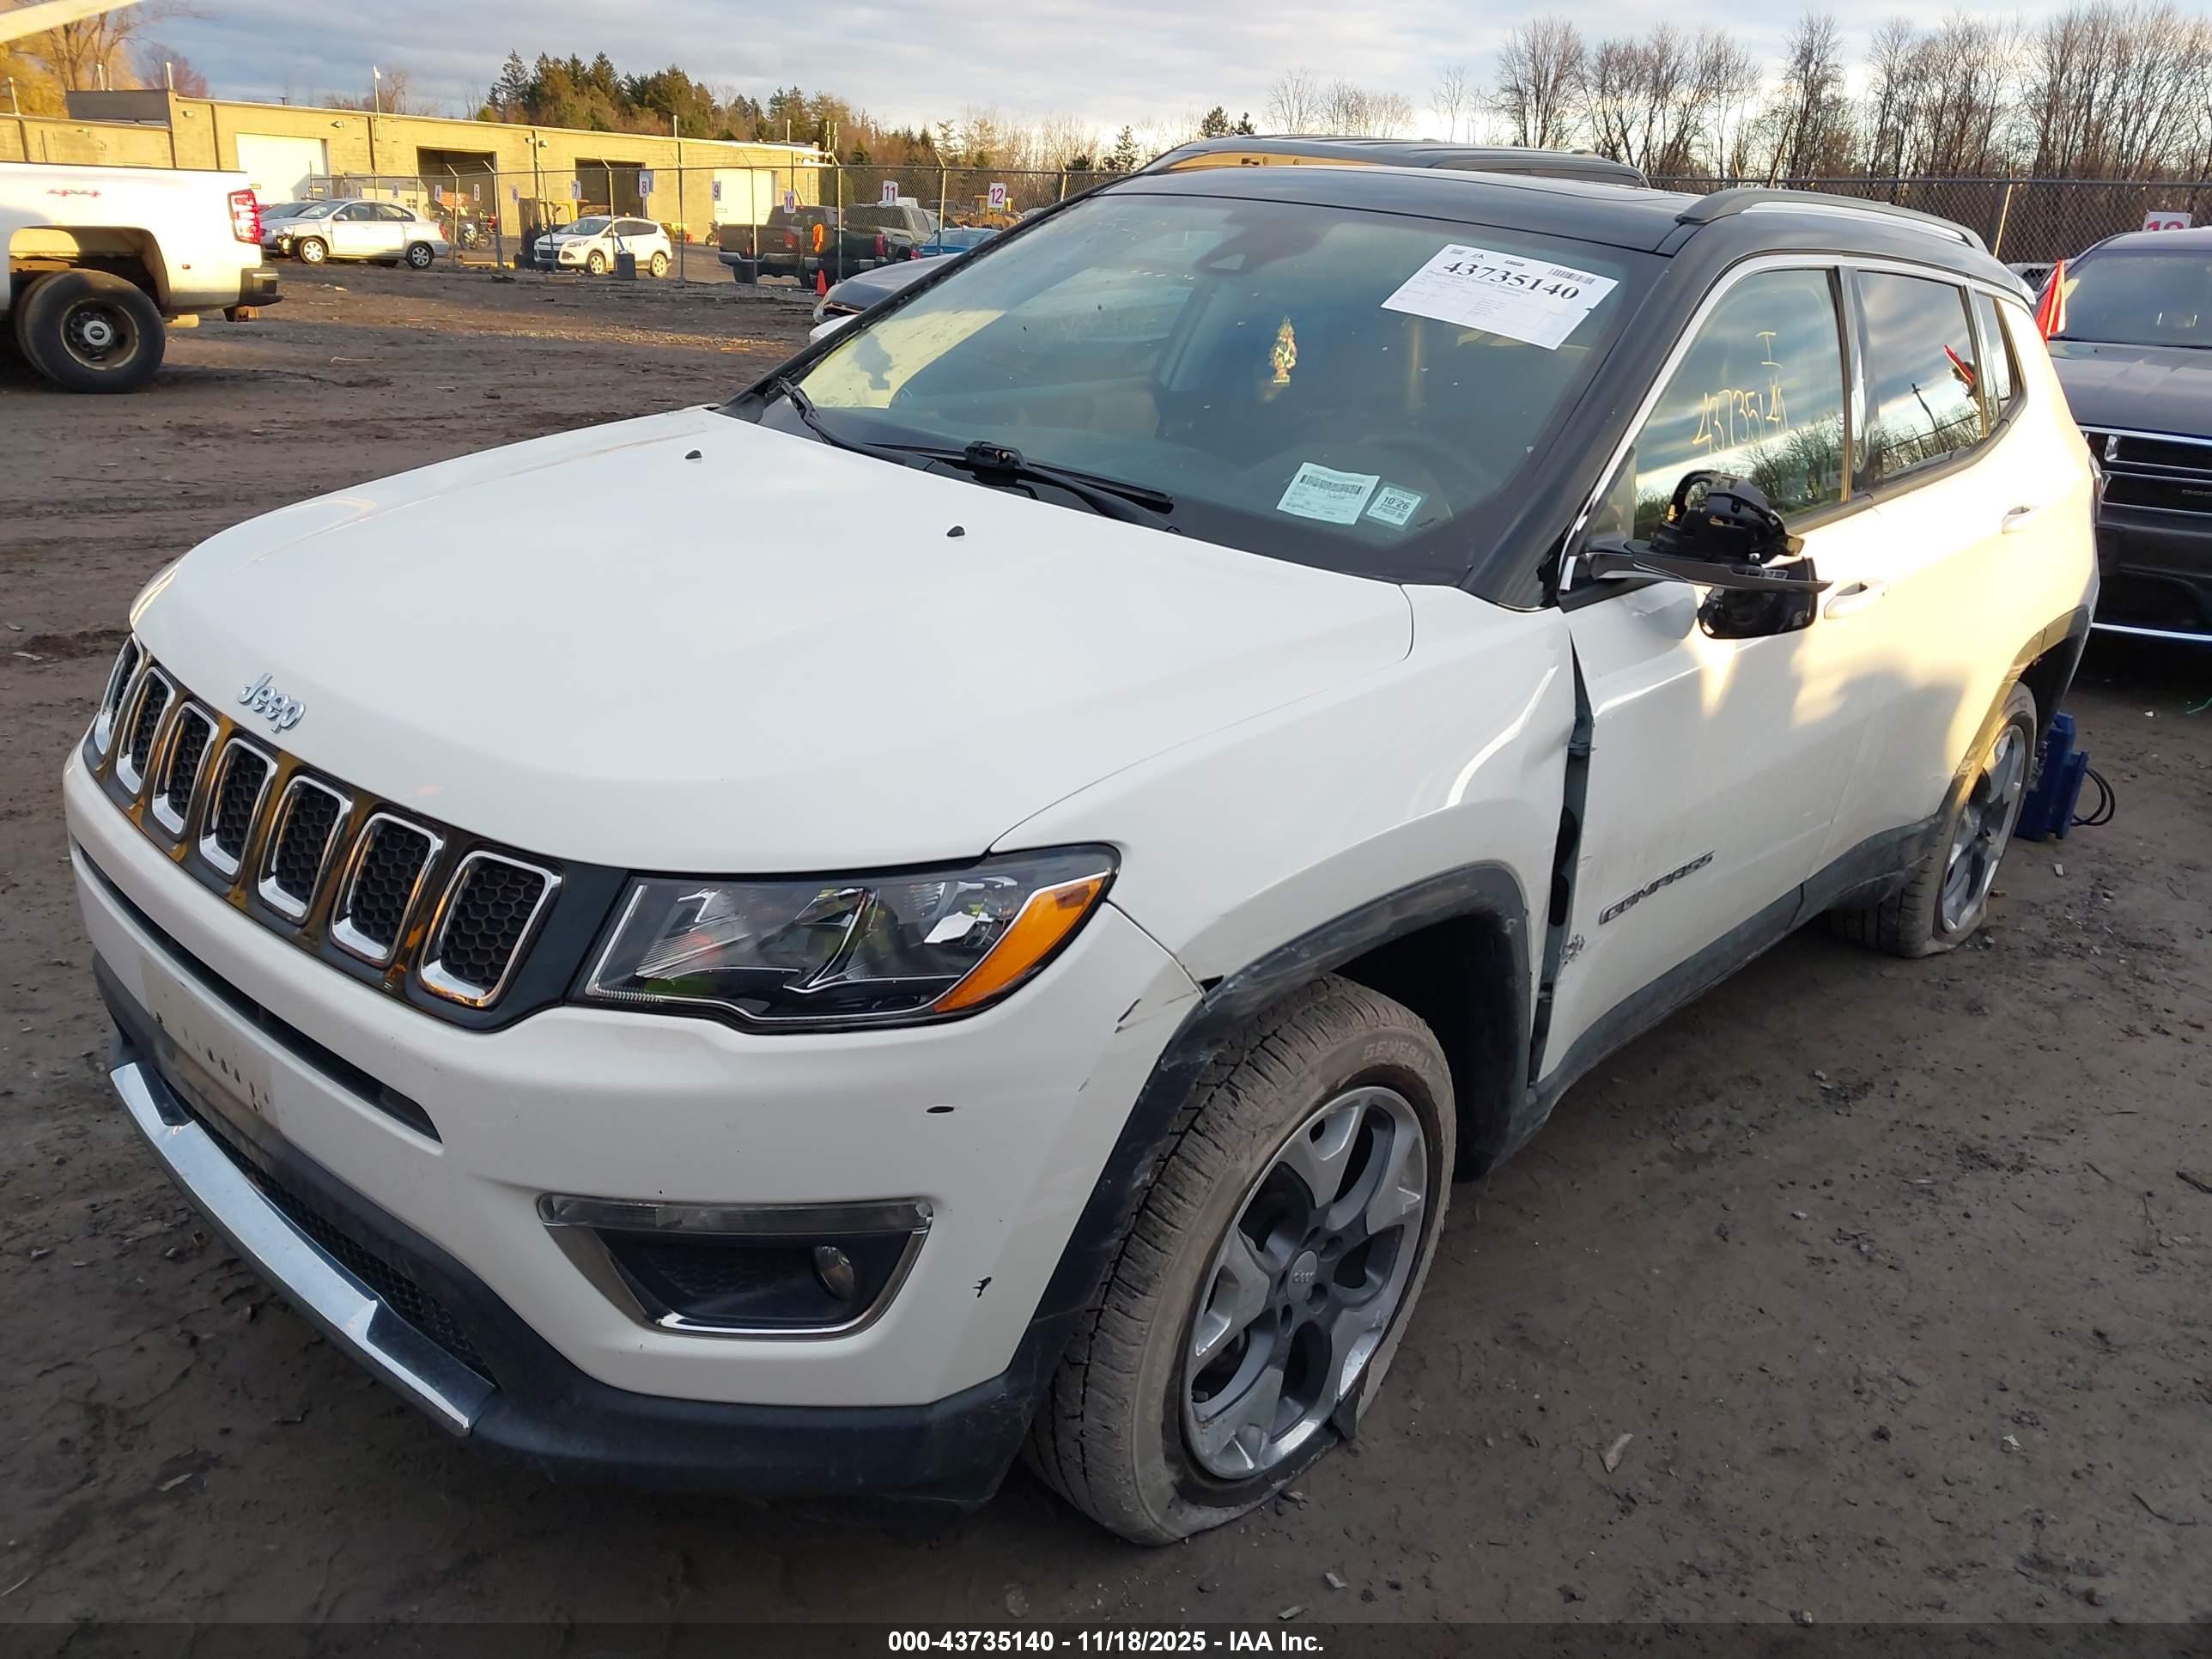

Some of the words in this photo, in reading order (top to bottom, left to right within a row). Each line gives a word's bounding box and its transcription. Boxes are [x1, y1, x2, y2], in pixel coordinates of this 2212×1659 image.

[641, 180, 647, 194] 8
[714, 185, 720, 198] 9
[884, 185, 896, 202] 11
[990, 187, 1004, 204] 12
[785, 195, 794, 210] 10
[1443, 260, 1580, 301] 43735140
[237, 673, 306, 734] Jeep
